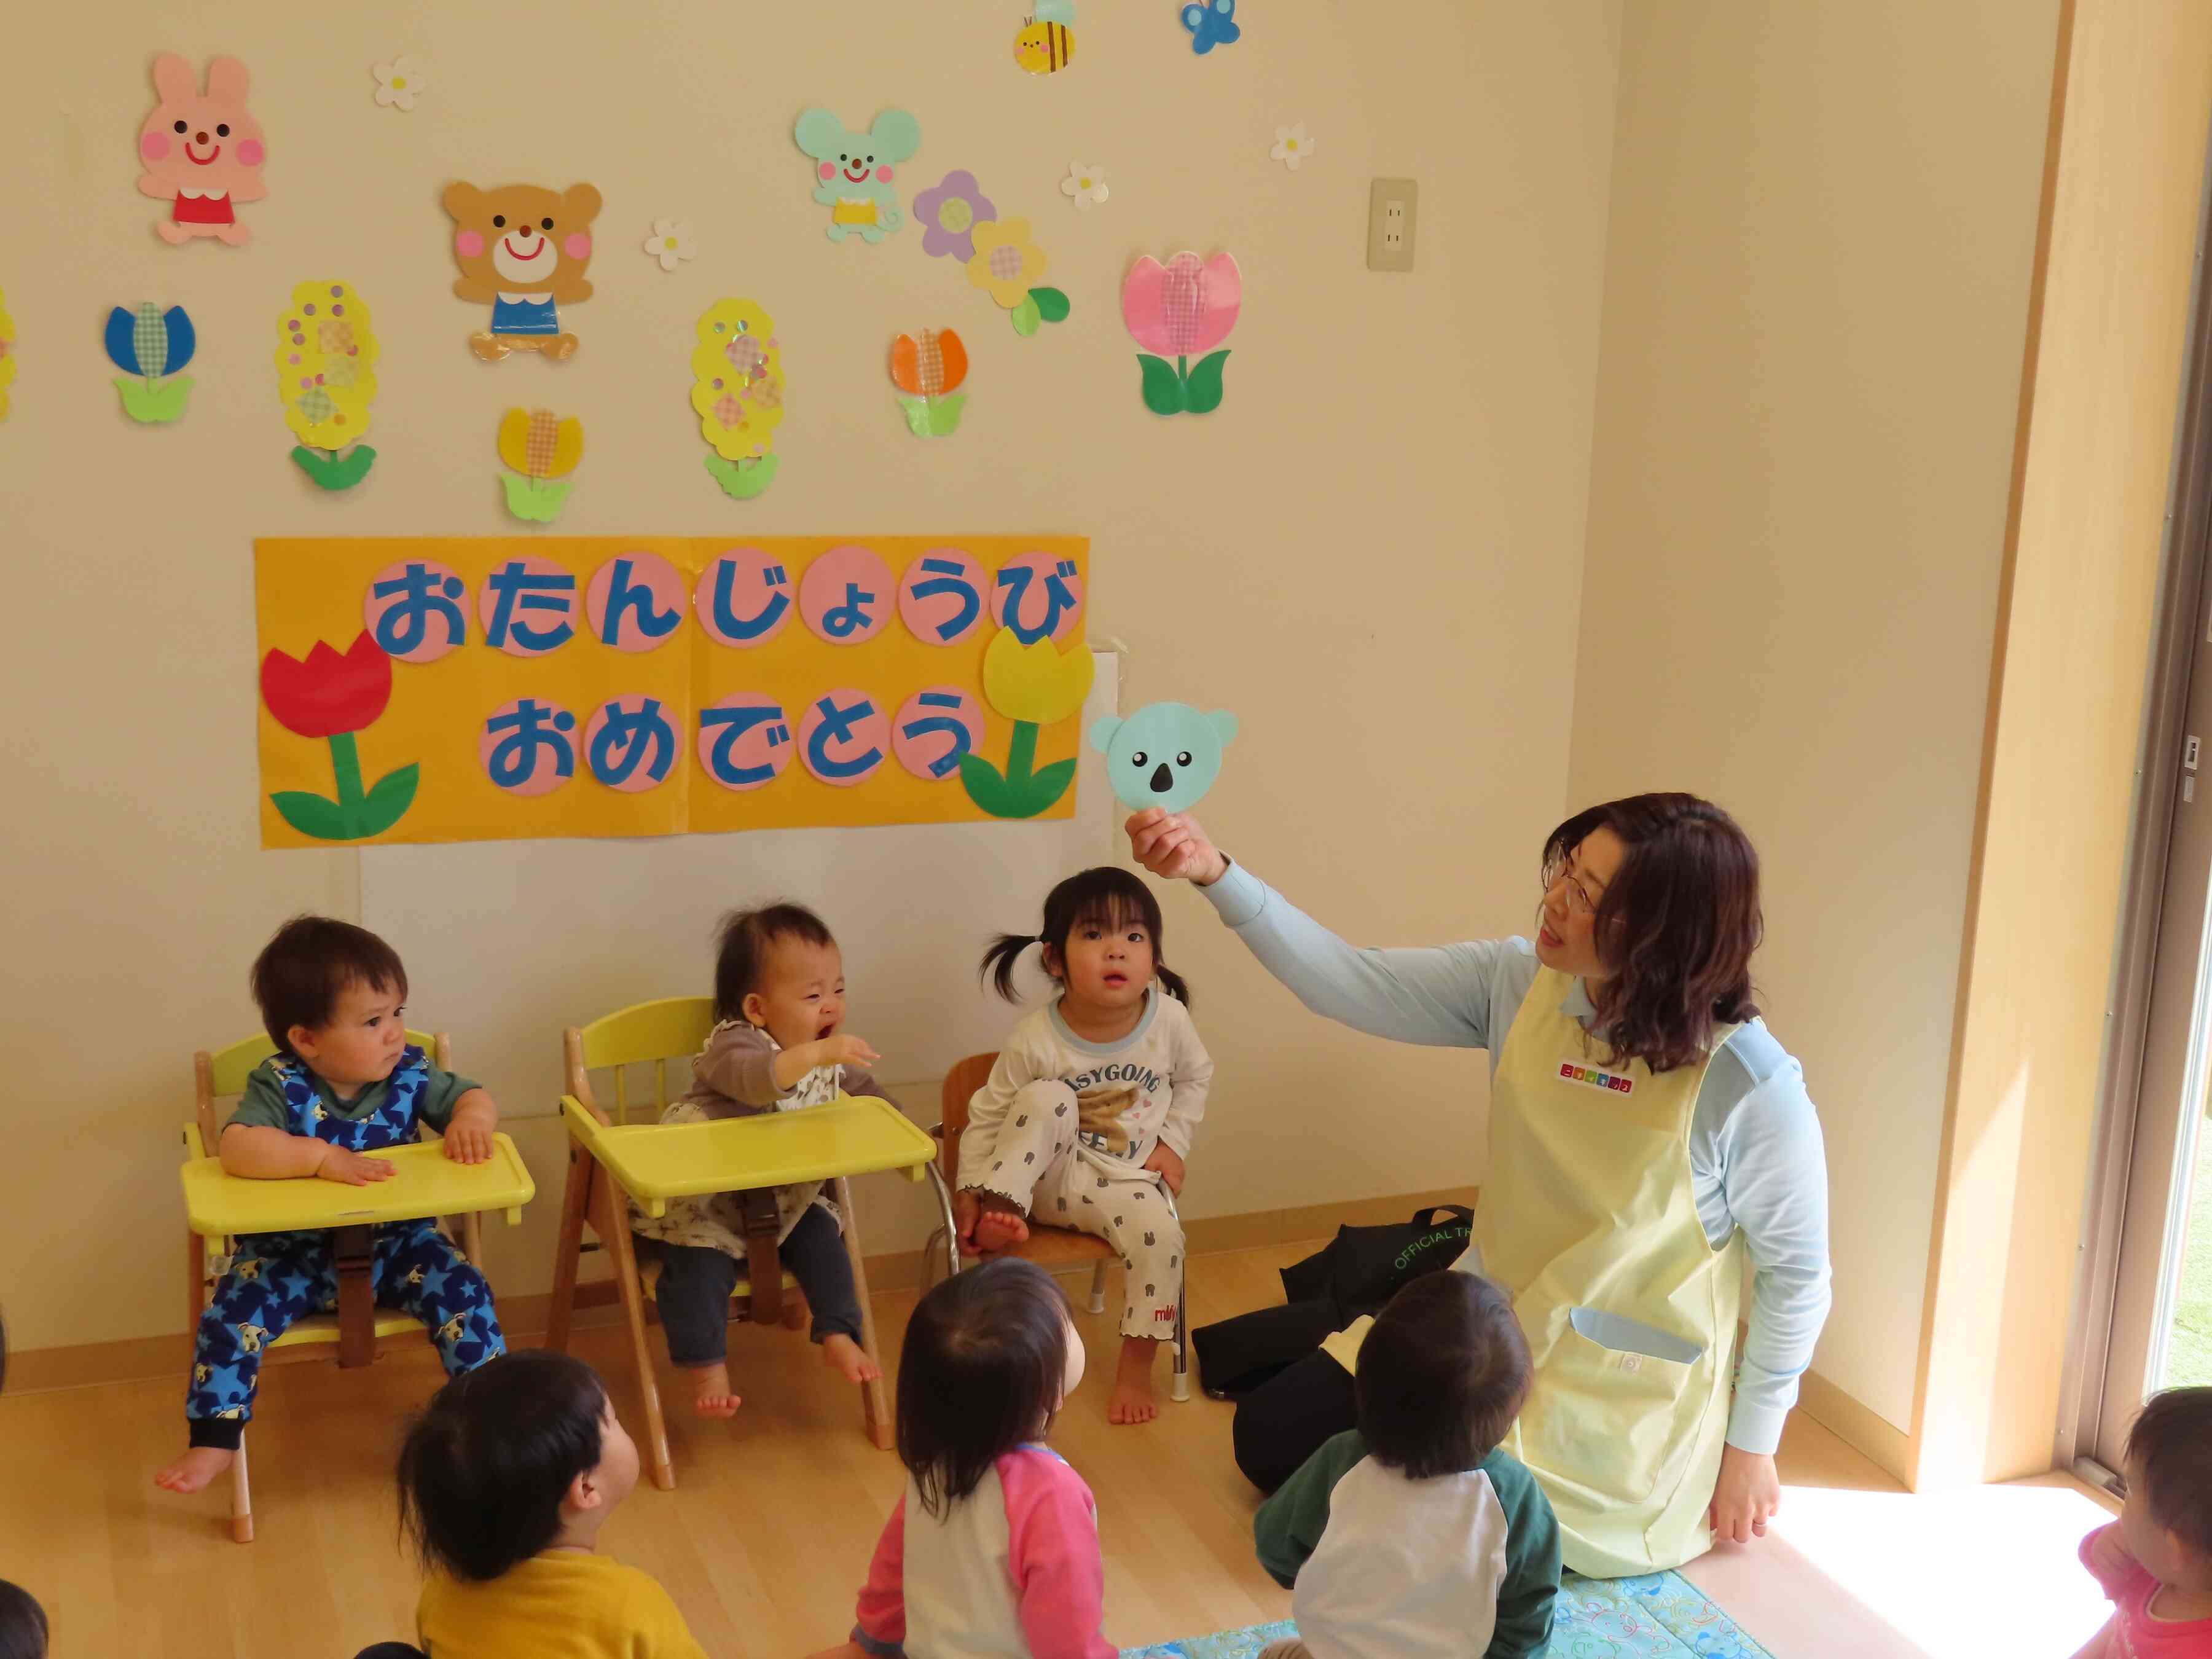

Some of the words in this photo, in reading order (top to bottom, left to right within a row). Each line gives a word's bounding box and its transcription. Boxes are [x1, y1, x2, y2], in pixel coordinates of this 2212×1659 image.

[374, 559, 1078, 654] おたんじょうび
[487, 693, 971, 787] おめでとう
[1064, 1064, 1160, 1092] SYGOING
[1395, 1230, 1452, 1269] OFFICIAL
